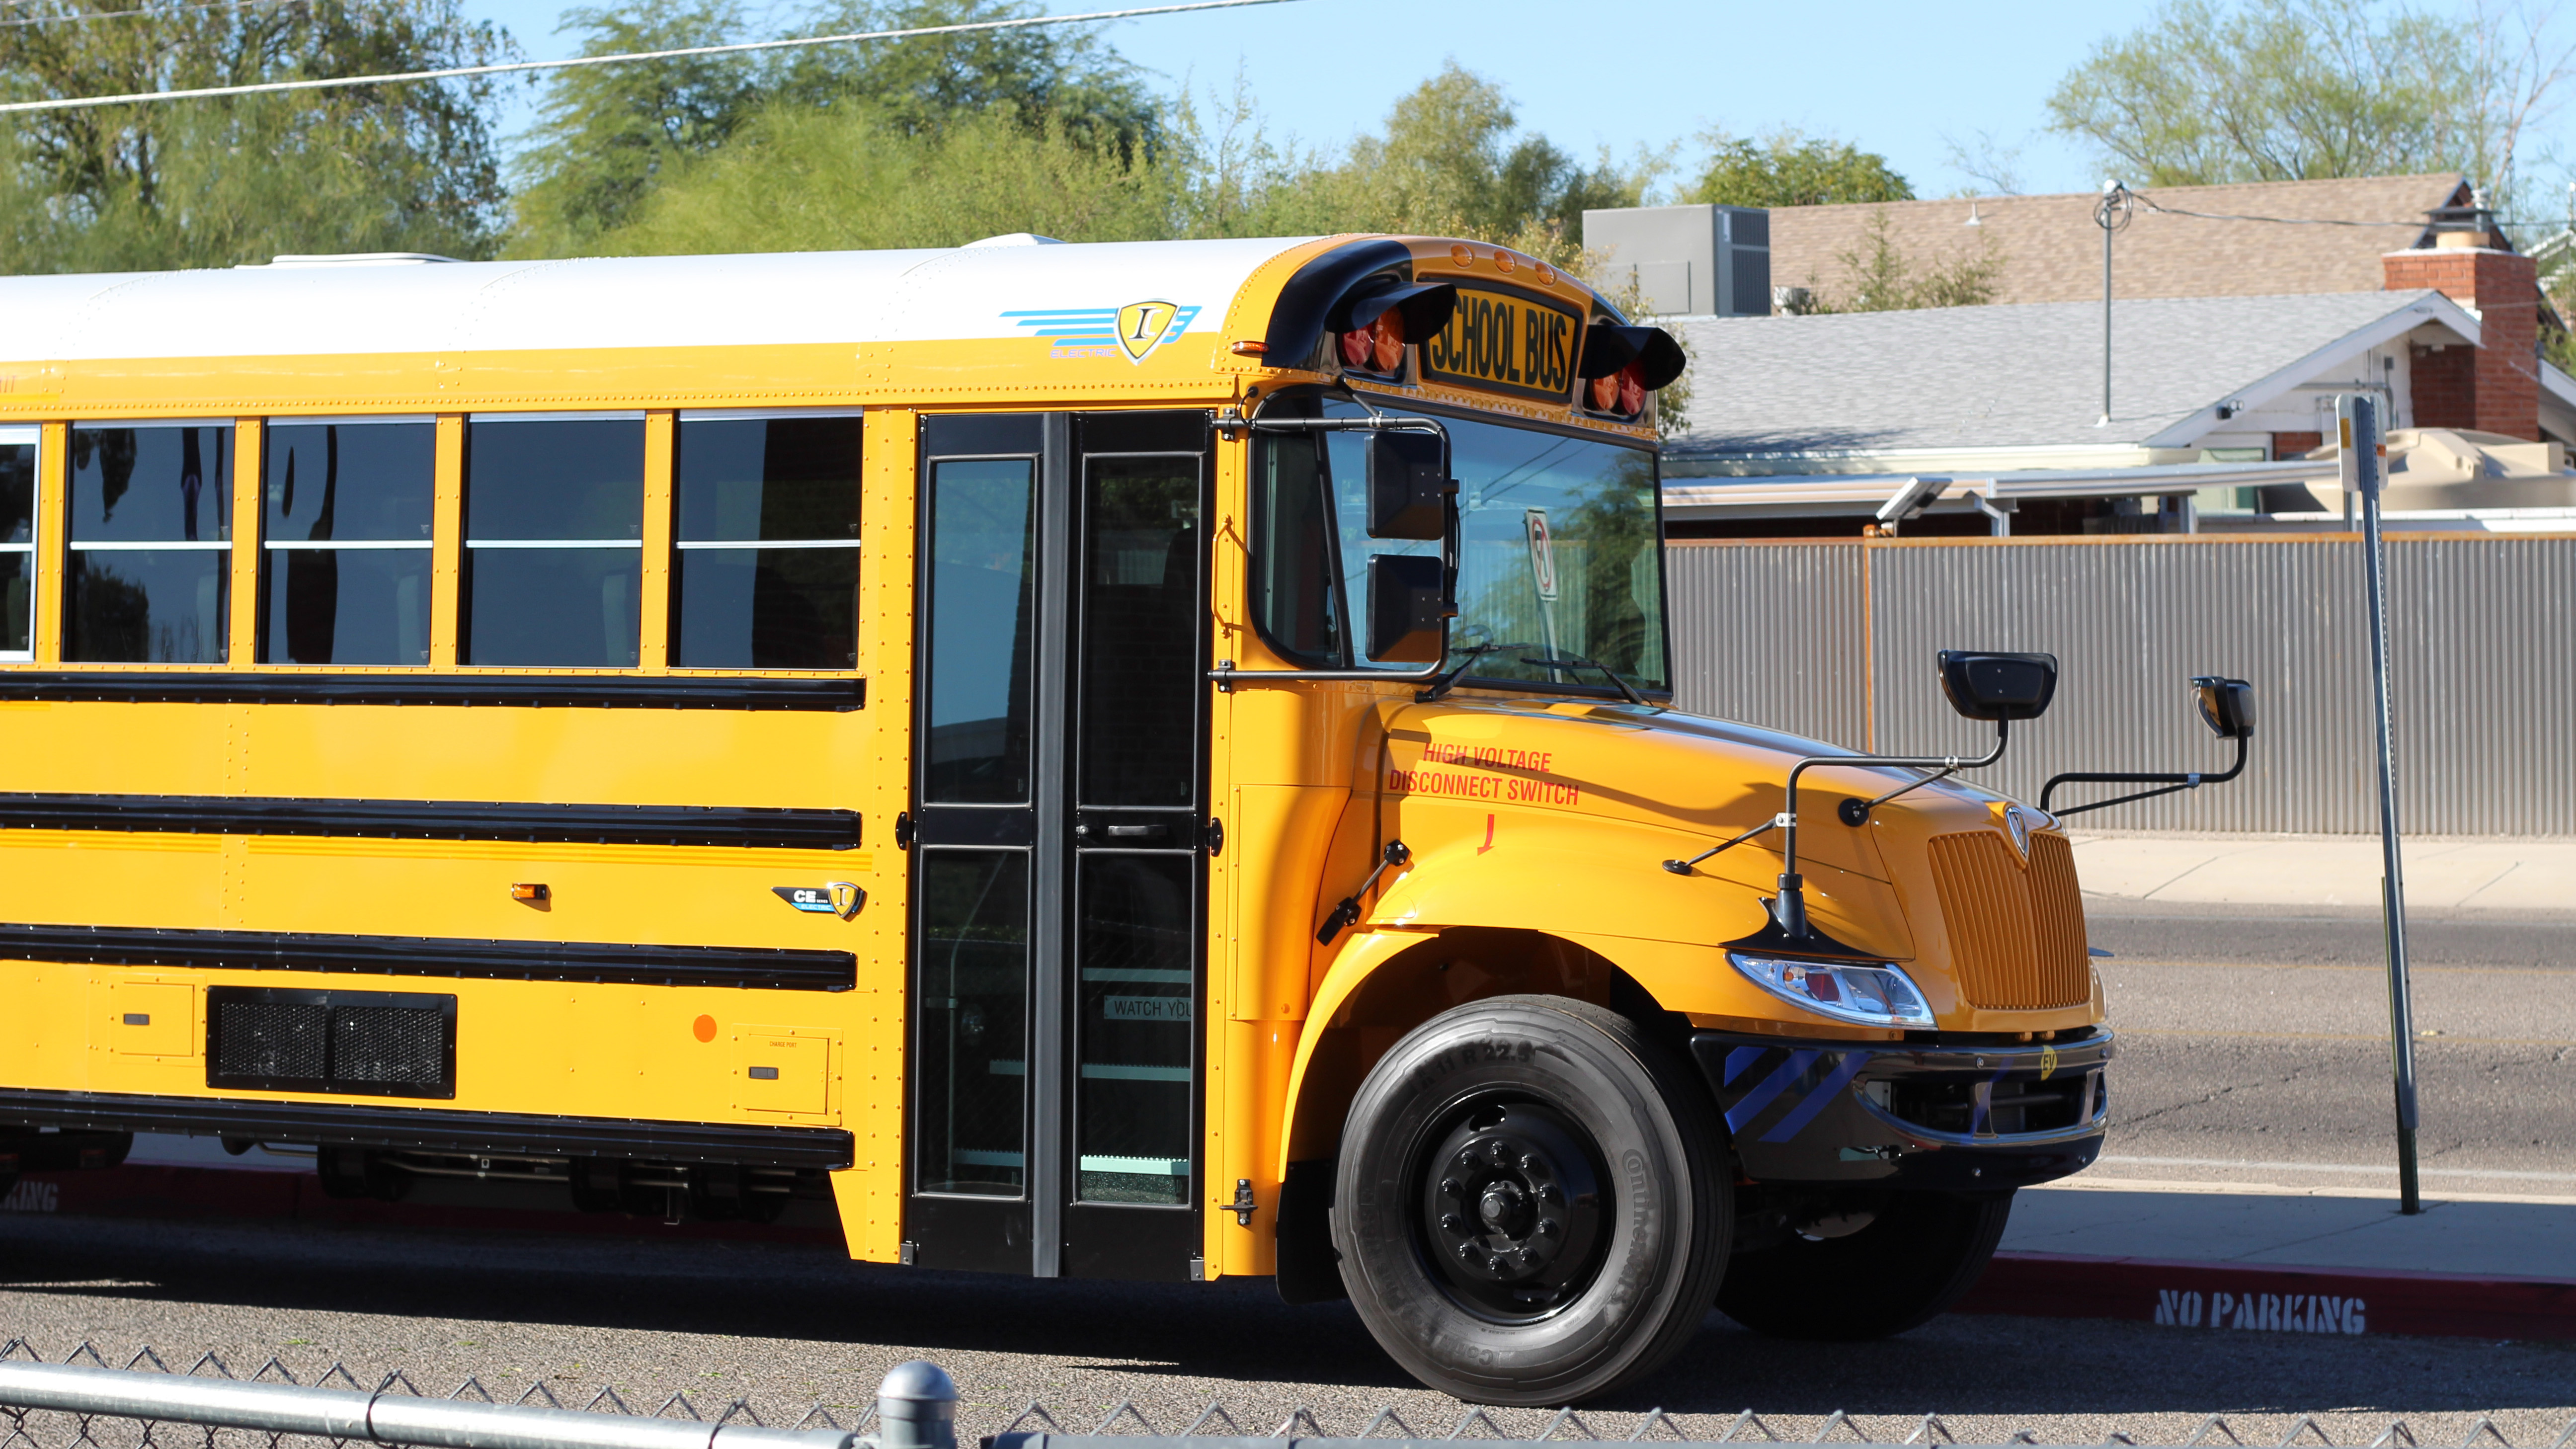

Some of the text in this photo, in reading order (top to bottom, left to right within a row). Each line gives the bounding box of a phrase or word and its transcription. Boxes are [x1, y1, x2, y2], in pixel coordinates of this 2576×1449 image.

[1050, 347, 1118, 359] ELECTRIC
[1431, 294, 1567, 391] SCHOOL BUS
[1423, 742, 1552, 773] HIGH VOLTAGE
[1389, 769, 1579, 805] DISCONNECT SWITCH
[793, 889, 816, 903] CE
[1114, 1000, 1161, 1017] WATCH
[2042, 1053, 2056, 1071] EV
[2155, 1289, 2366, 1335] NO PARKING
